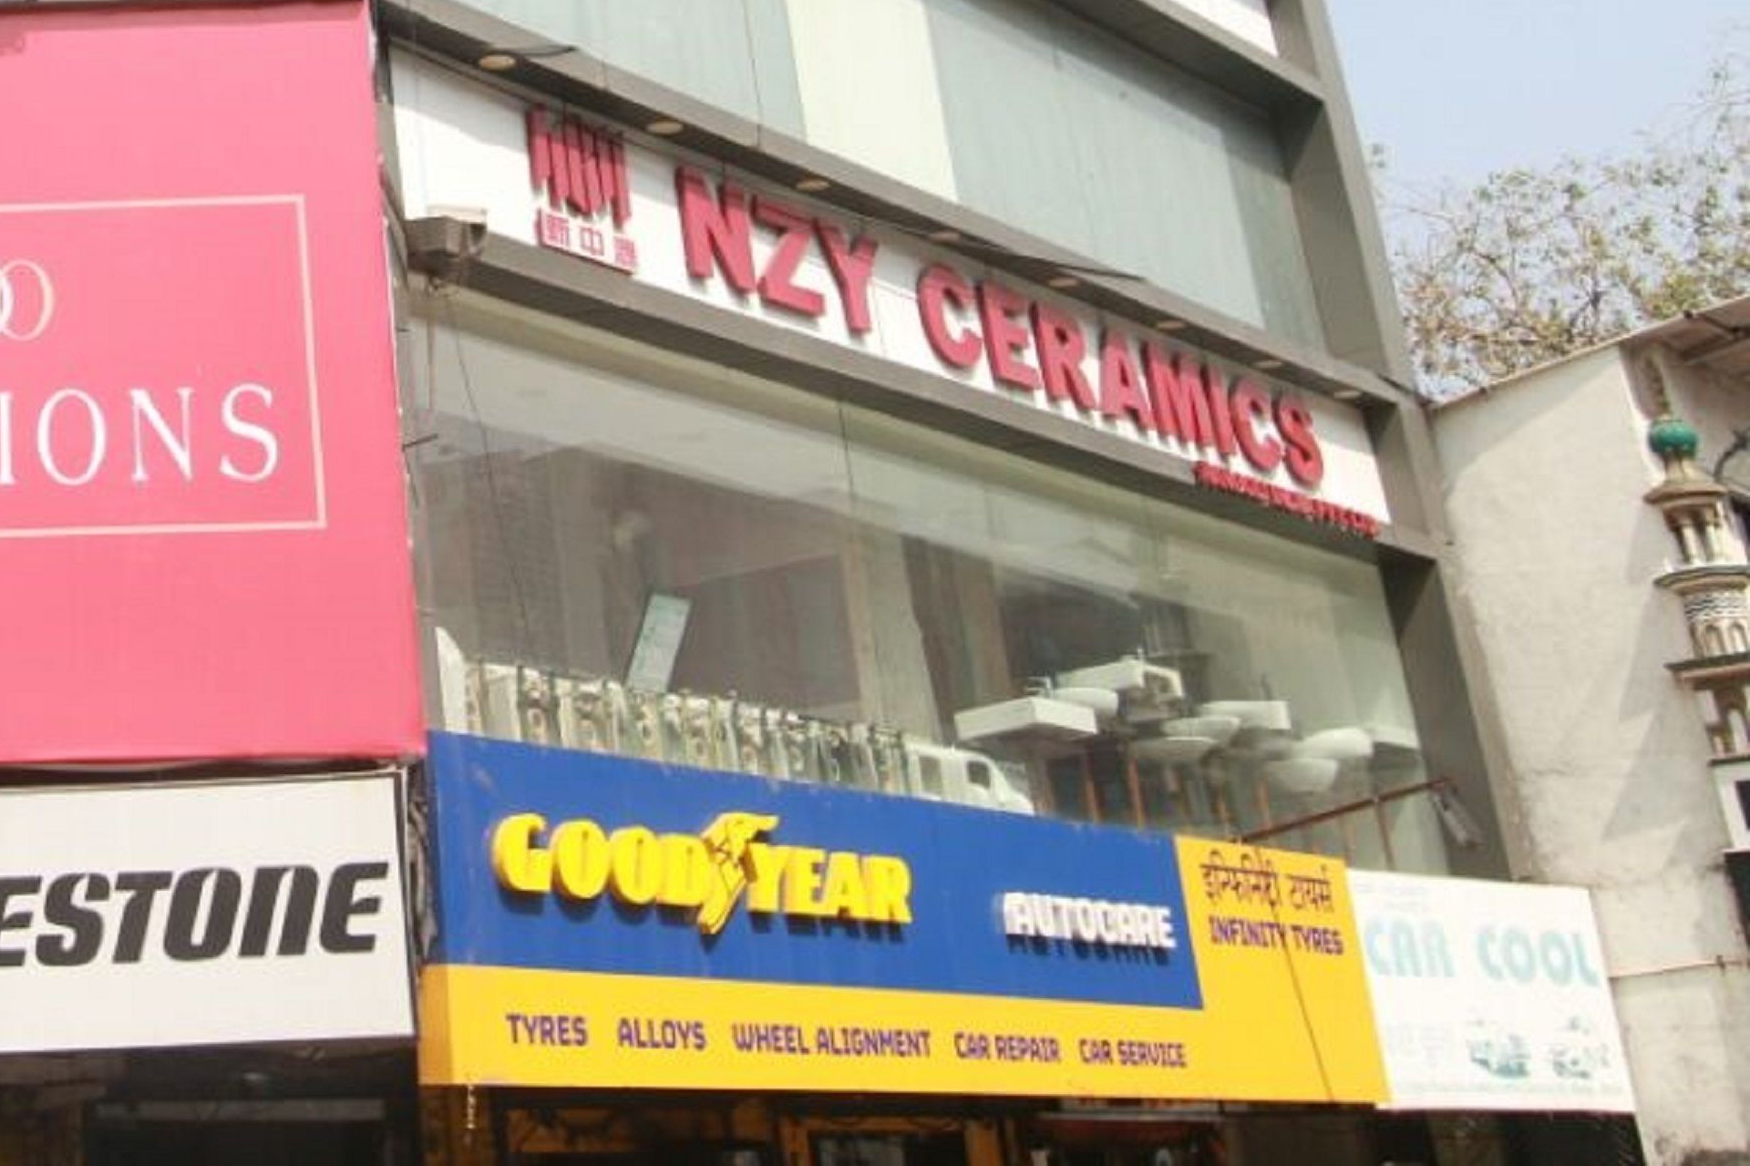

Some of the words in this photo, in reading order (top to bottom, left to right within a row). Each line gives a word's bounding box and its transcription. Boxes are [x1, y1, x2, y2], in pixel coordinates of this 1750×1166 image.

[676, 166, 879, 335] NZY
[918, 263, 1325, 491] CERAMICS
[490, 811, 914, 935] GOODYEAR
[998, 891, 1177, 949] AUTOCARE
[1208, 913, 1286, 949] INFINITY
[1290, 923, 1344, 956] TYRES
[1365, 917, 1455, 979] CAR
[1476, 926, 1602, 988] COOL
[505, 1012, 589, 1048] TYRES
[616, 1016, 706, 1051] ALLOYS
[731, 1022, 811, 1056] WHEEL
[817, 1026, 932, 1060] ALIGNMENT
[954, 1031, 991, 1060] CAR
[994, 1034, 1063, 1064] REPAIR
[1079, 1038, 1114, 1065] CAR
[1117, 1040, 1188, 1069] SERVICE
